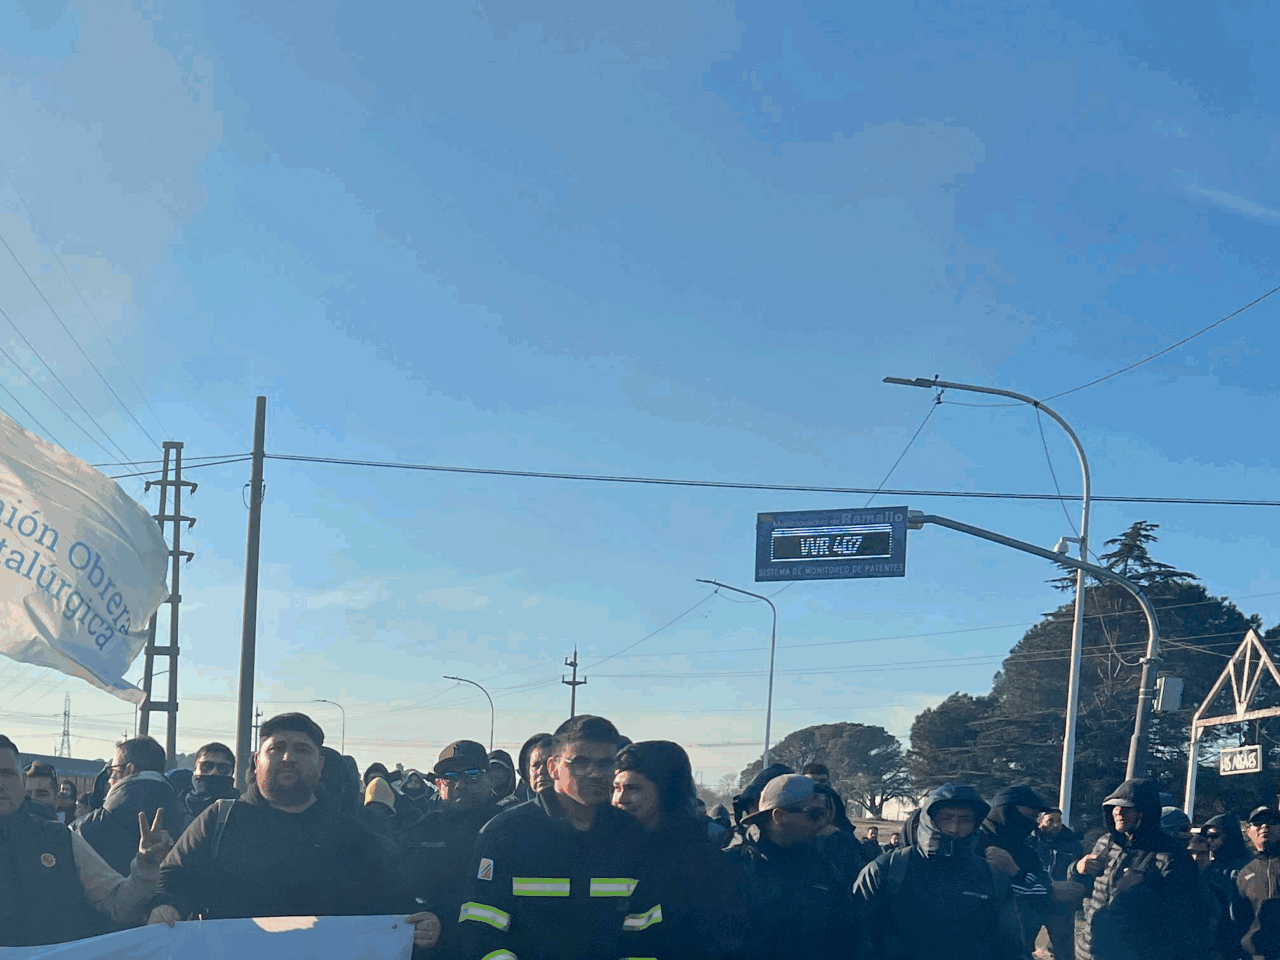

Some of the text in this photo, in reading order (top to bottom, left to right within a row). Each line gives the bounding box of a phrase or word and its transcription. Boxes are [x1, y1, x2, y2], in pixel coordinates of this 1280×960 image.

[841, 511, 904, 524] Ramallo
[833, 536, 863, 554] 407
[759, 563, 904, 577] SISTEMA DE MONITOREO DE PATENTES
[68, 541, 132, 636] Obrera
